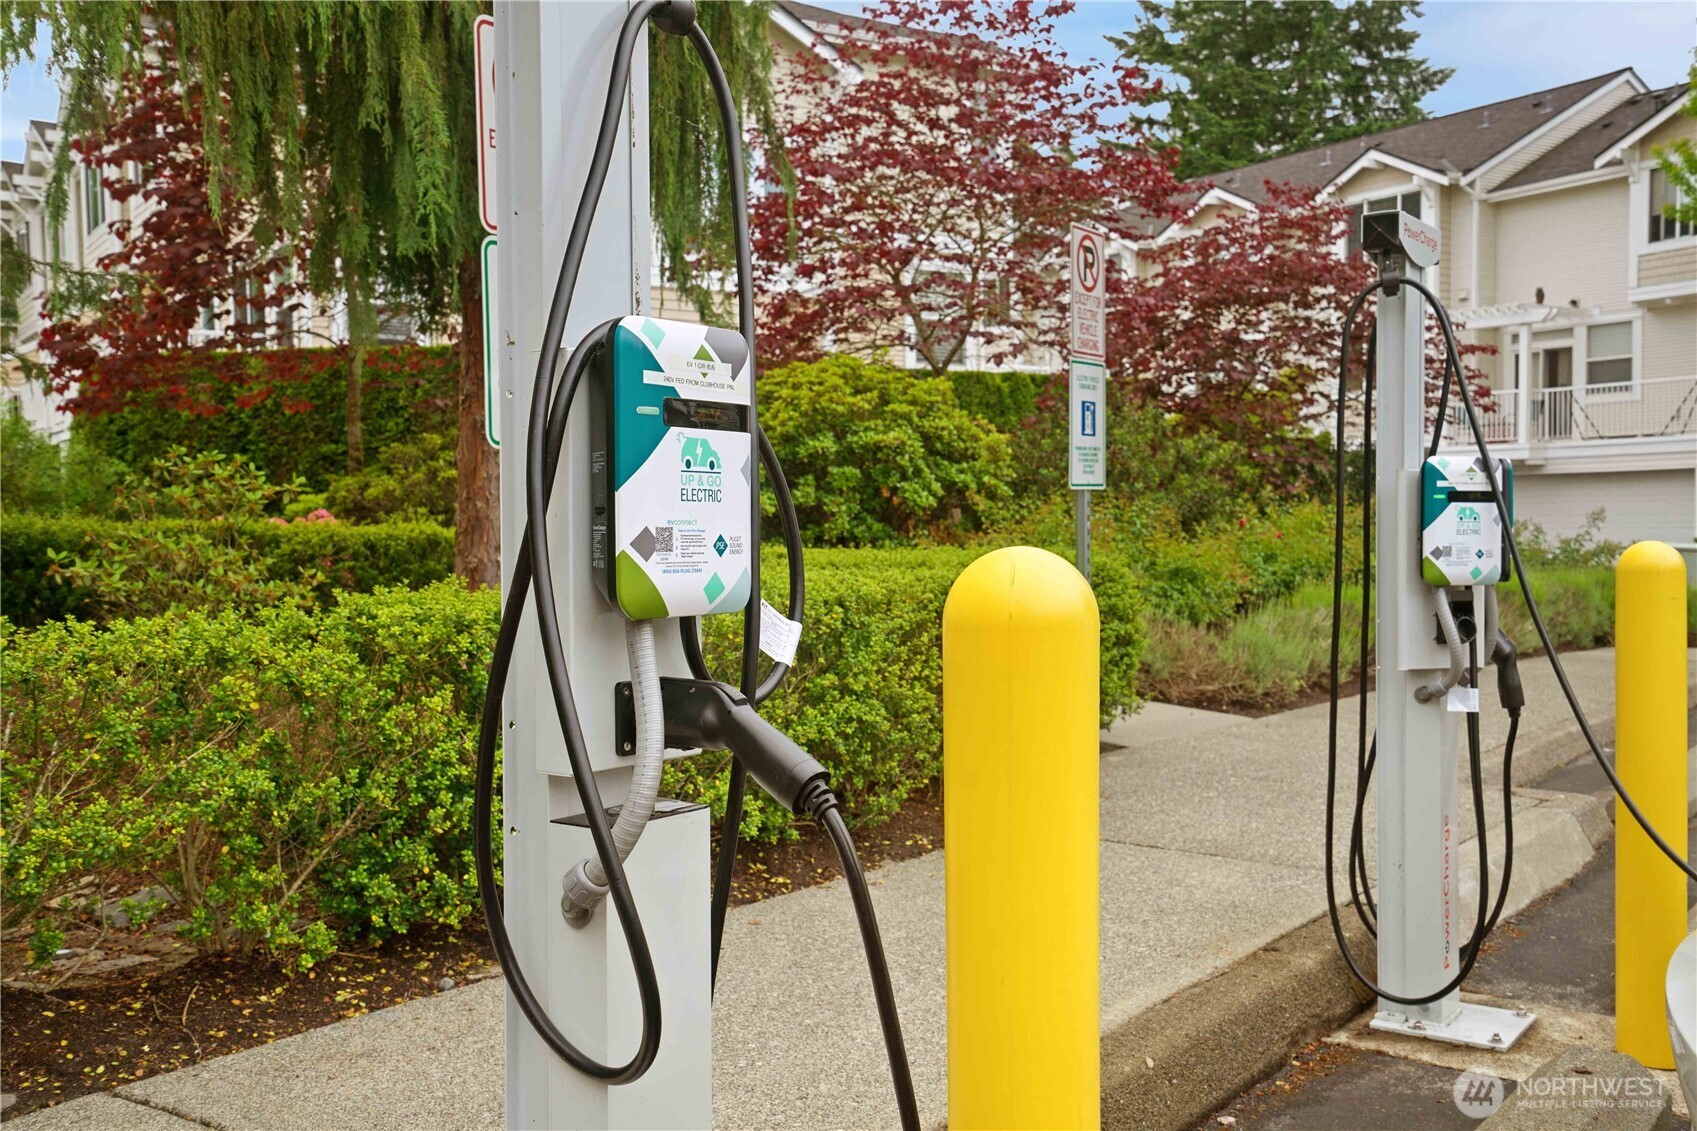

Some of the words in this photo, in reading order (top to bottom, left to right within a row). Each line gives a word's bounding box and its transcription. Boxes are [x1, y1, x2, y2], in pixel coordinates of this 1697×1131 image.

[1403, 222, 1438, 253] PowerCharge
[1075, 290, 1092, 306] EXCEPT
[1077, 307, 1099, 323] ELECTRIC
[1079, 322, 1098, 337] VEHICLE
[1077, 336, 1099, 352] CHARGING
[675, 377, 685, 385] FED
[699, 381, 726, 390] CLUBHOUSE
[680, 474, 694, 486] UP
[697, 475, 704, 487] &
[707, 475, 722, 487] GO
[680, 488, 722, 503] ELECTRIC
[1456, 528, 1482, 536] ELECTRIC
[715, 541, 725, 550] PSE
